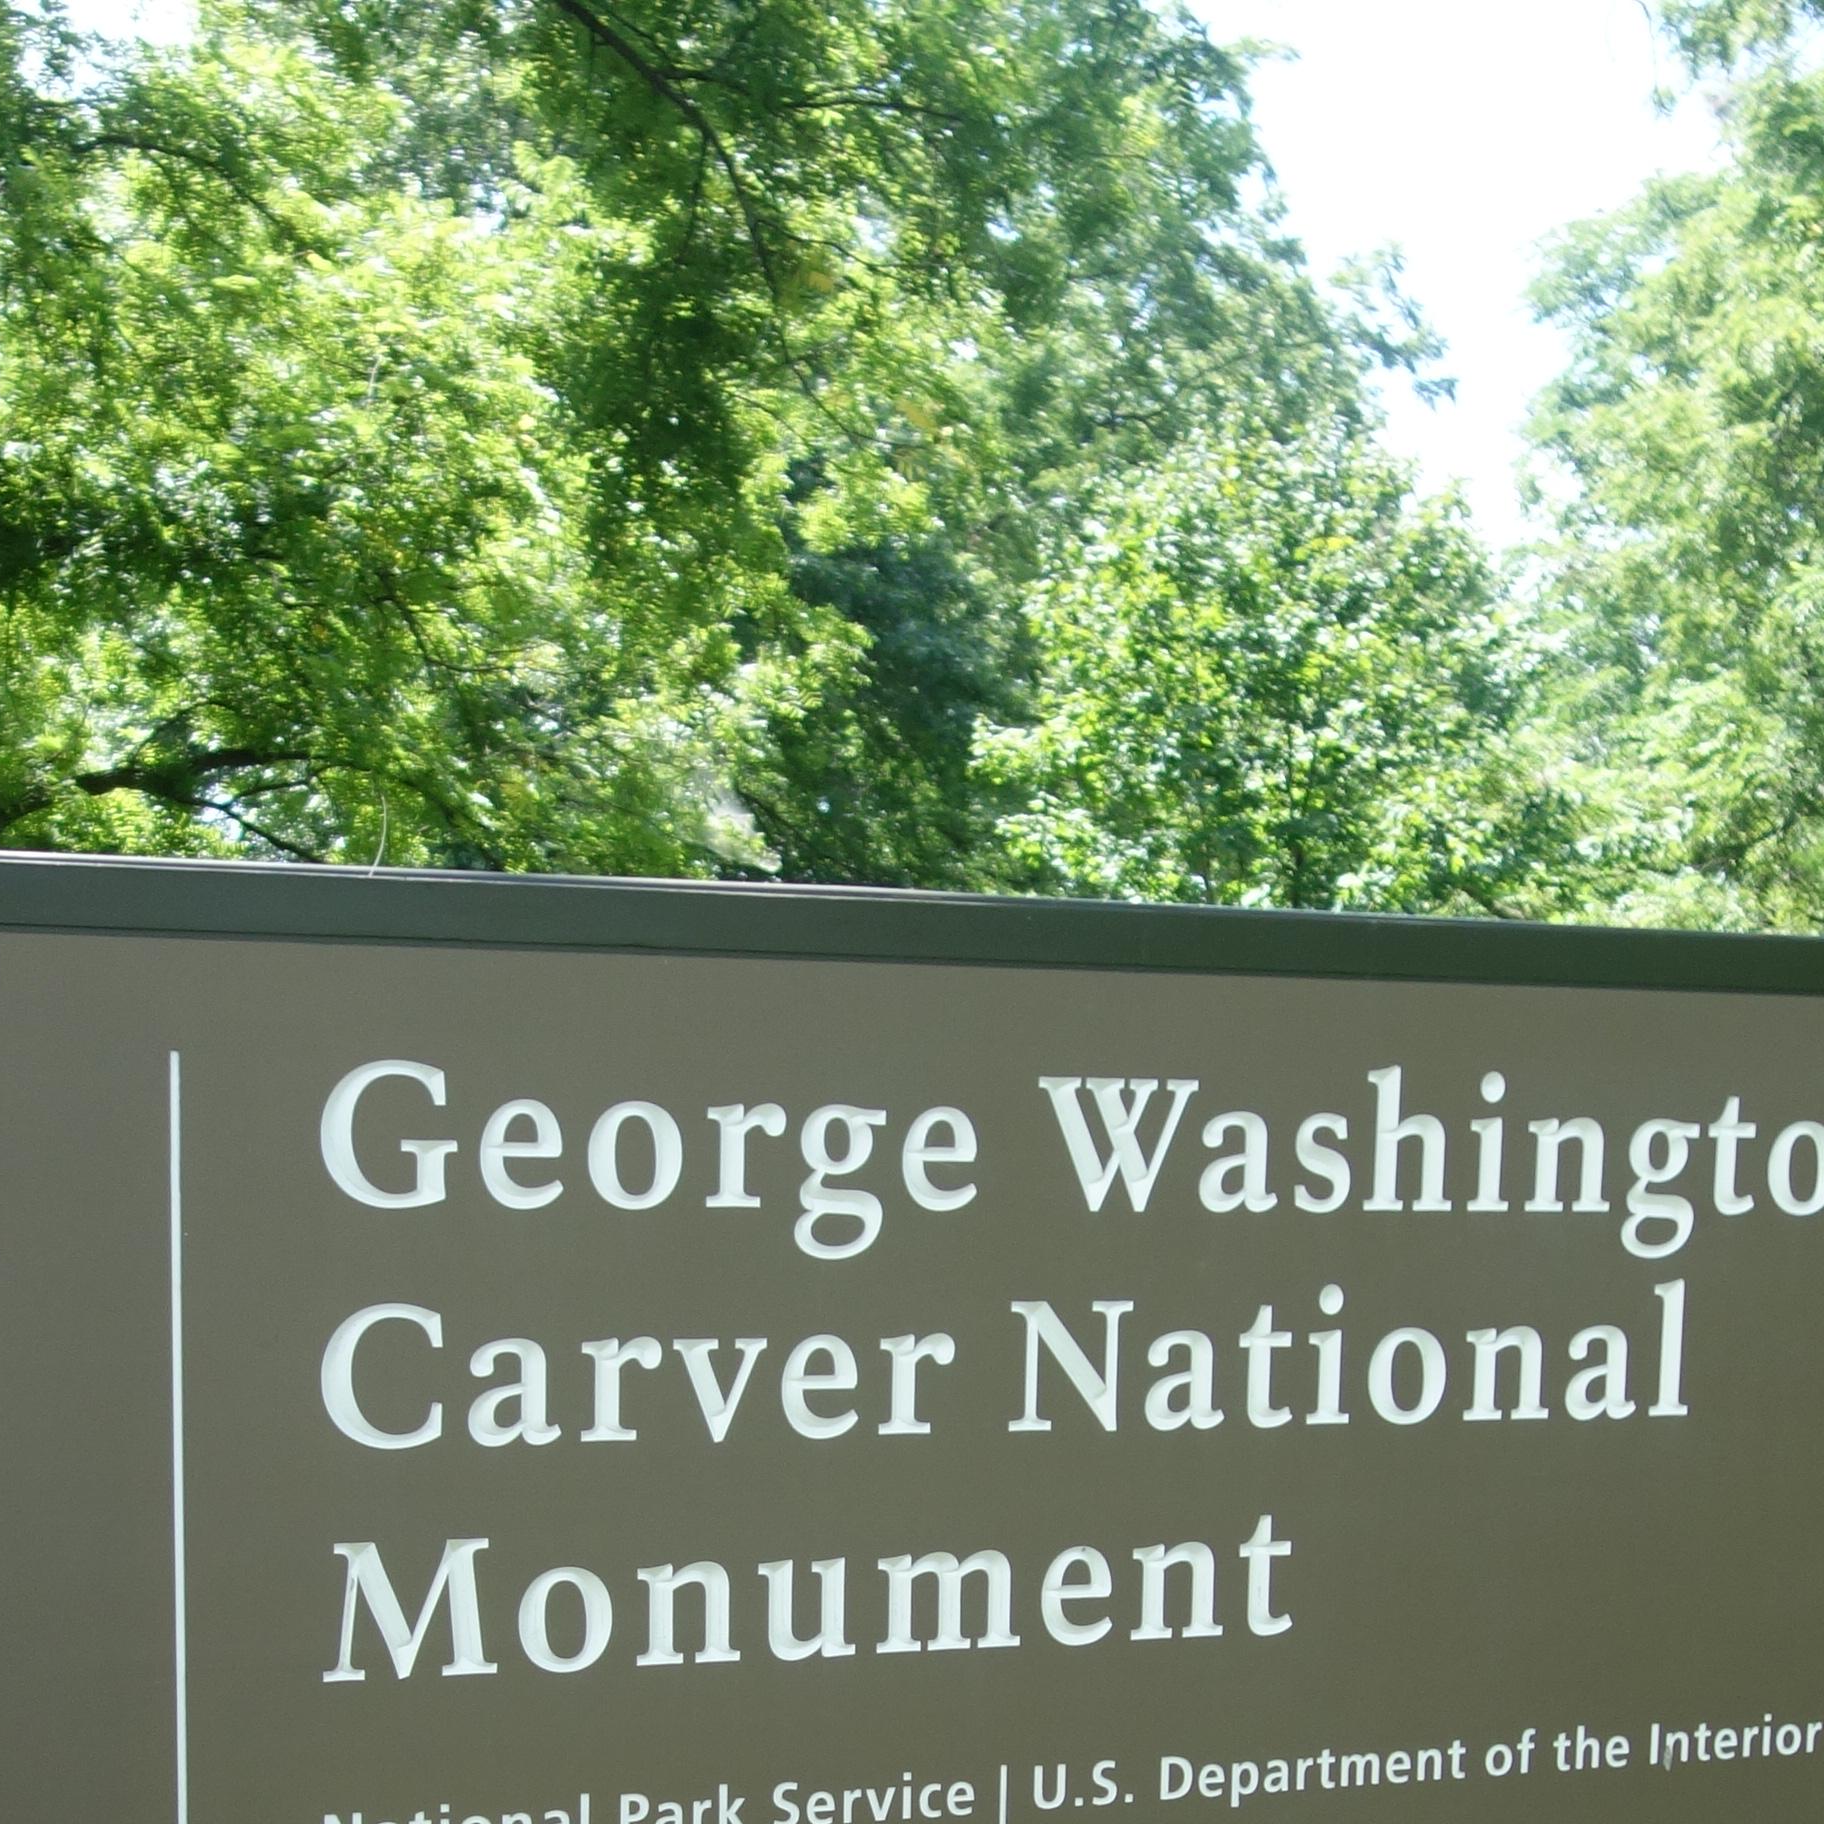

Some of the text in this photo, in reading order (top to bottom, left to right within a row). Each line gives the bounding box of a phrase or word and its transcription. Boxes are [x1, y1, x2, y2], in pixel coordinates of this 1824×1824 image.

[319, 1059, 978, 1261] George
[320, 1278, 1689, 1450] Carver National
[322, 1514, 1293, 1683] Monument
[1033, 1759, 1134, 1810] U.S.
[1159, 1739, 1467, 1808] Department
[1485, 1727, 1536, 1777] of
[1552, 1725, 1630, 1772] the
[1649, 1713, 1823, 1770] Interior
